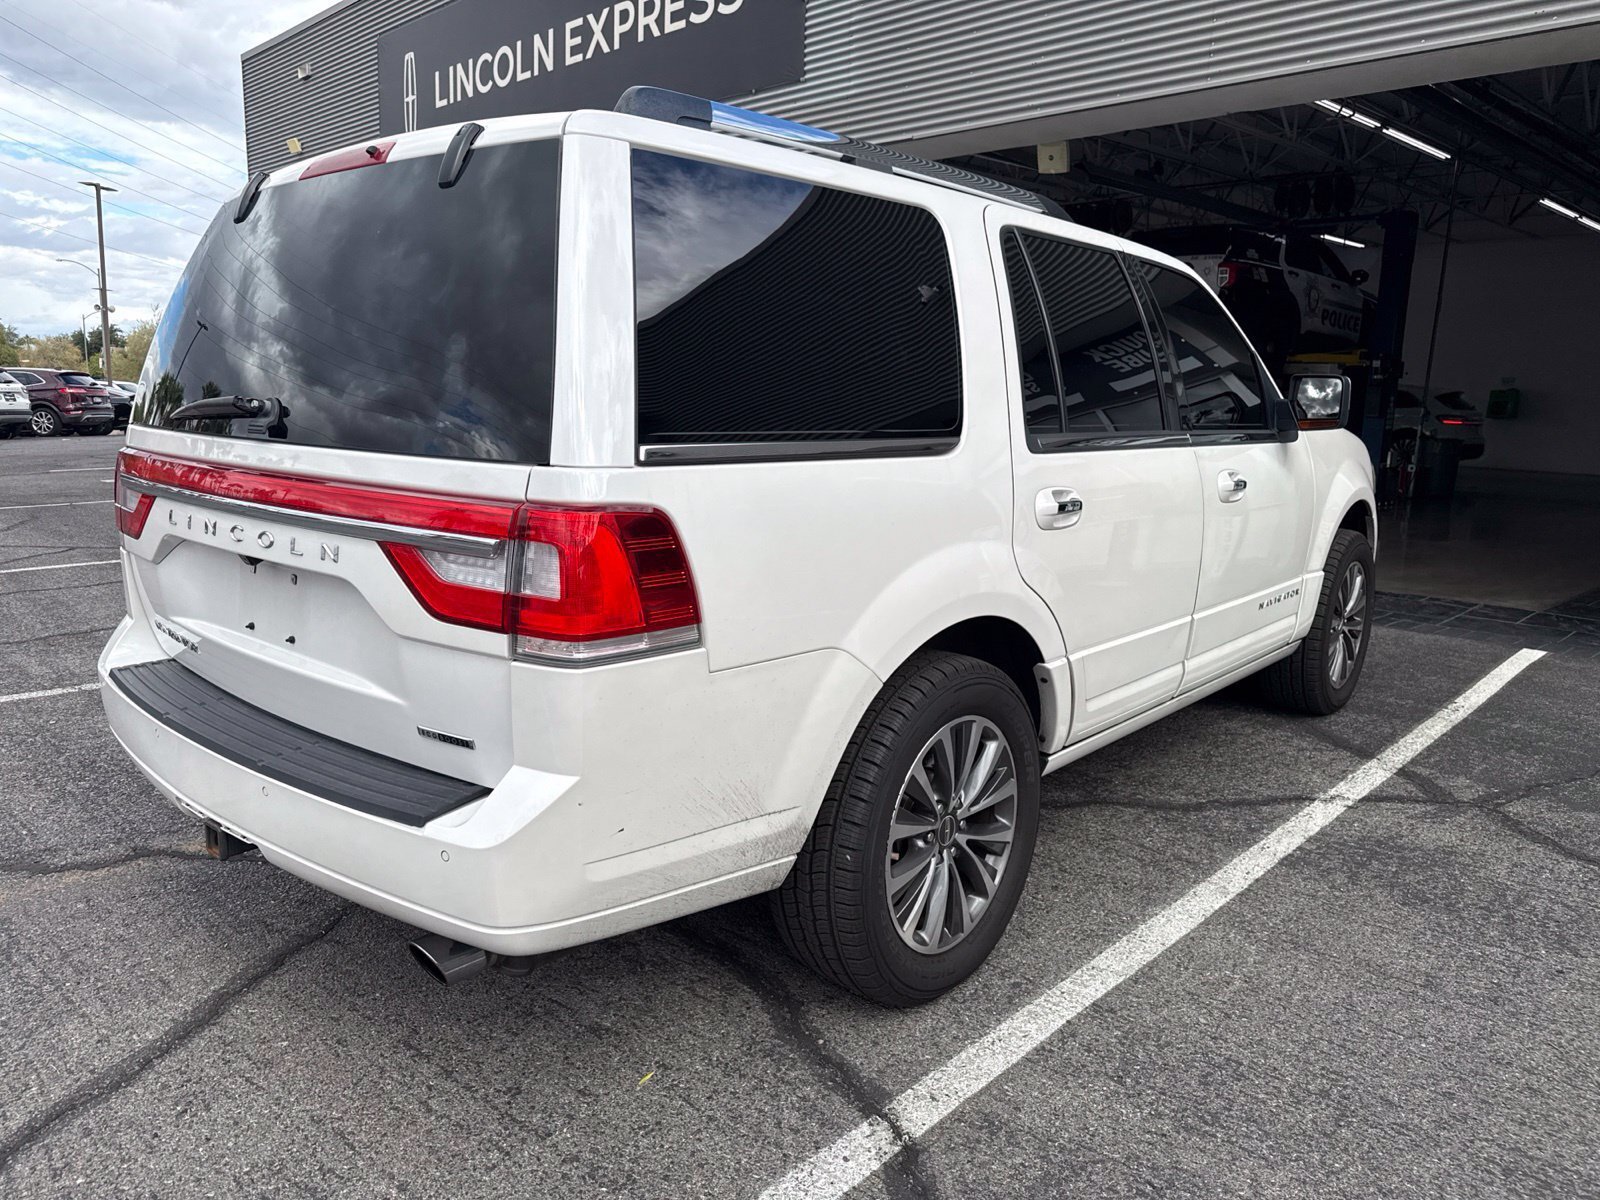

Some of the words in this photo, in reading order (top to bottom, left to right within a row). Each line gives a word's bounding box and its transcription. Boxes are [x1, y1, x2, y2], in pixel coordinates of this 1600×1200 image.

[434, 28, 555, 109] LINCOLN
[1321, 307, 1361, 332] POLICE
[168, 509, 340, 563] LINCOLN
[1257, 588, 1300, 611] NAVIGATOR
